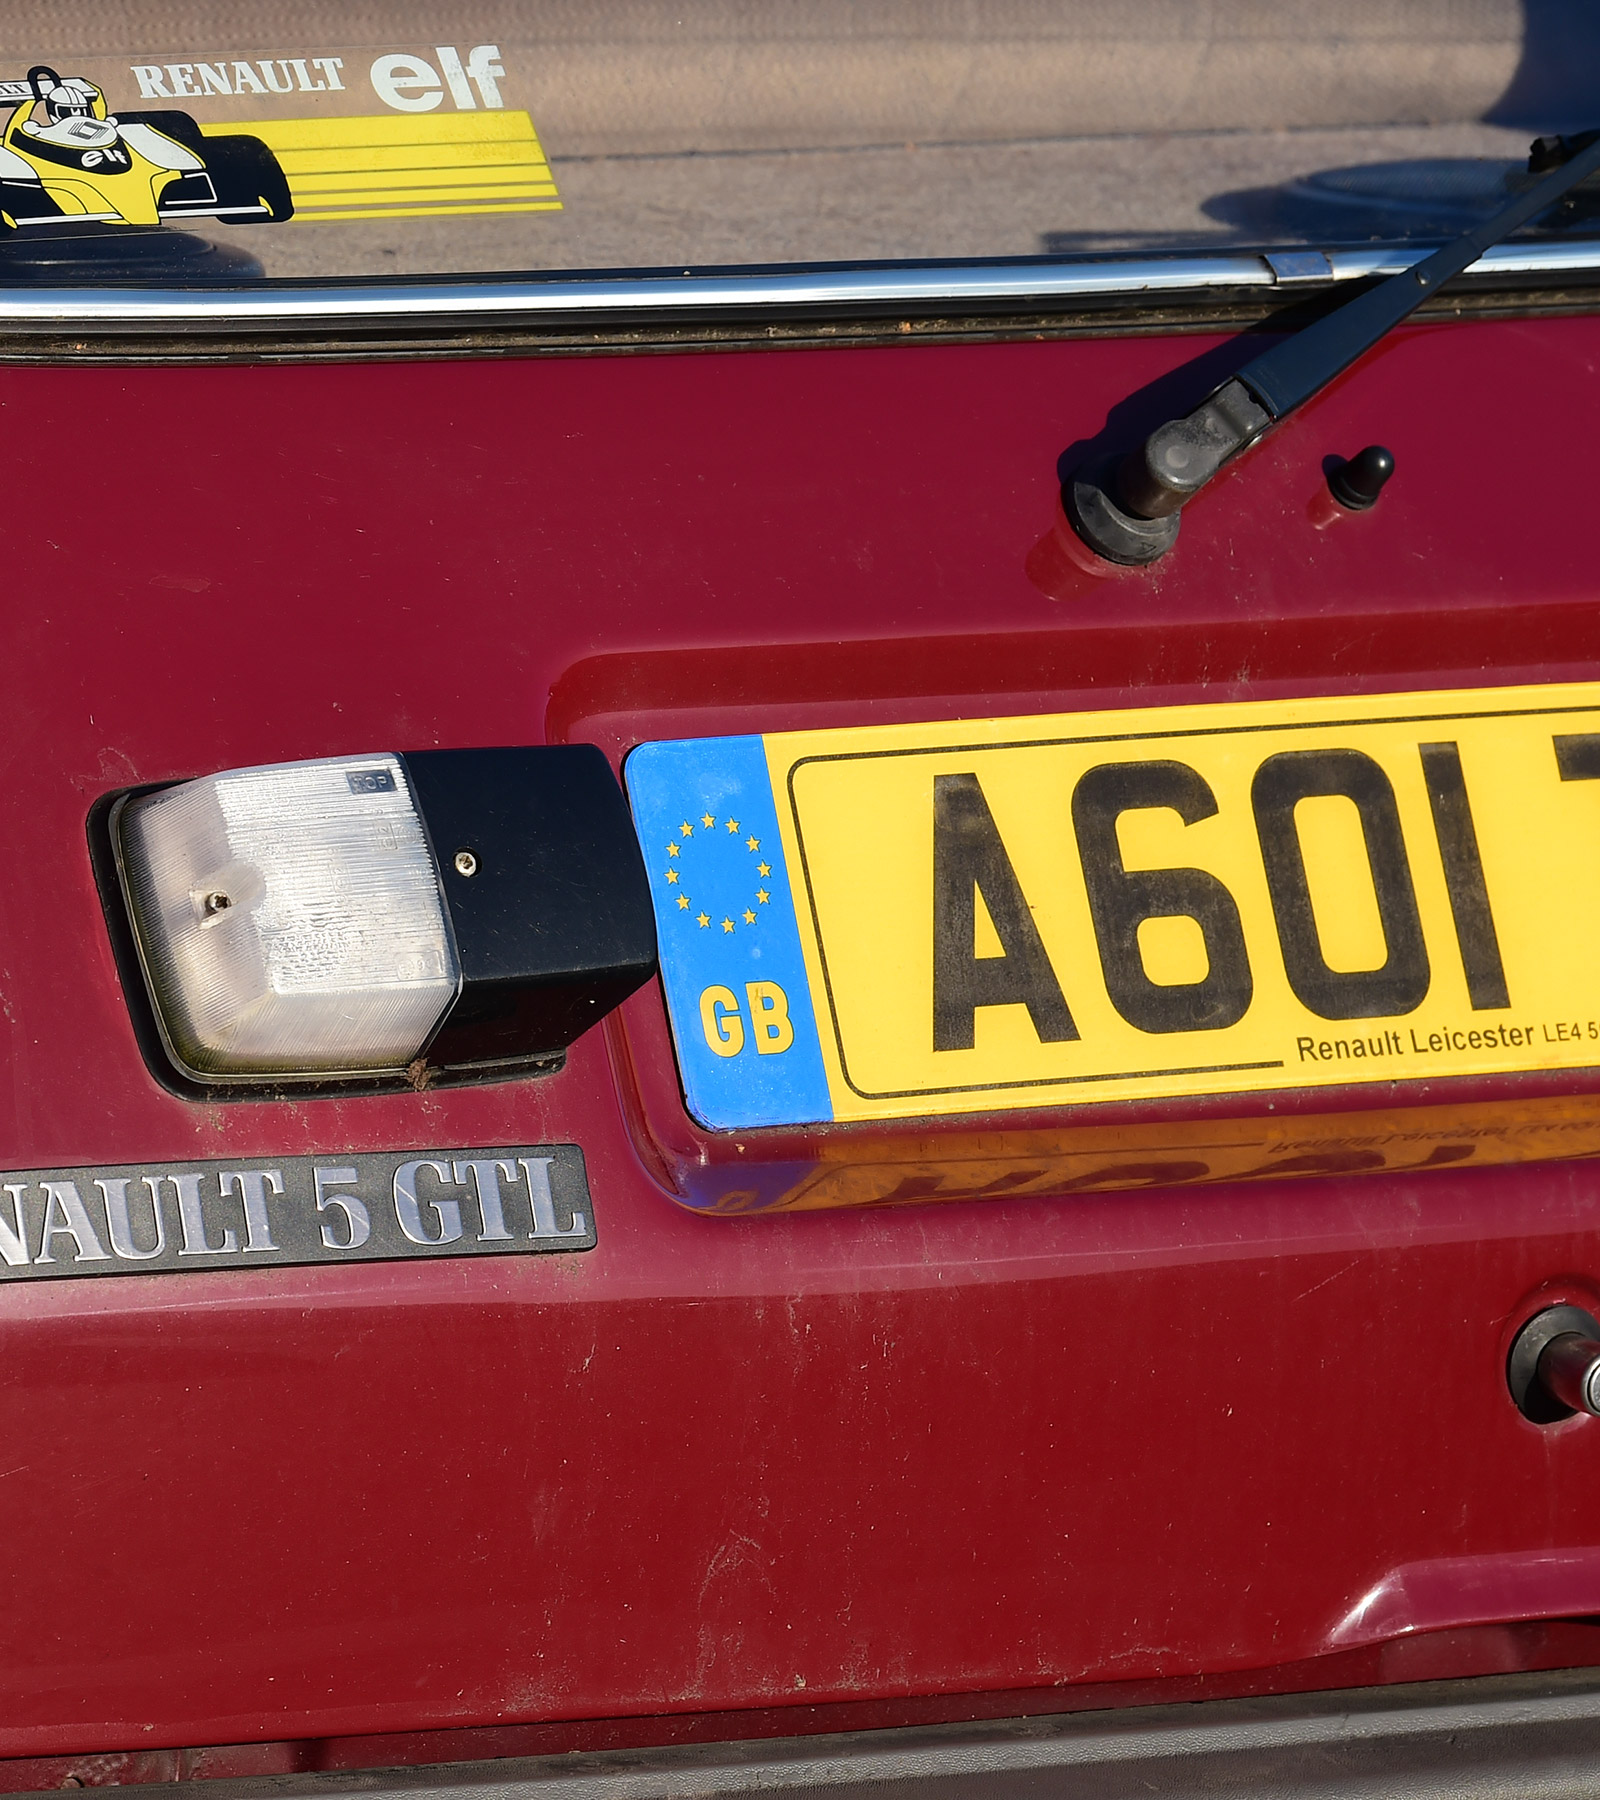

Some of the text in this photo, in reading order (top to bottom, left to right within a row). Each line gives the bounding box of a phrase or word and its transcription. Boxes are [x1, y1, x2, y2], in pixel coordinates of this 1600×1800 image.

[129, 45, 505, 112] RENAULT elf
[81, 149, 128, 168] elf
[352, 775, 389, 793] TOP
[933, 740, 1513, 1052] A601
[698, 980, 795, 1059] GB
[1296, 1021, 1600, 1062] Renault Leicester LE4 5
[315, 1166, 371, 1251] 5
[391, 1157, 587, 1246] GTL
